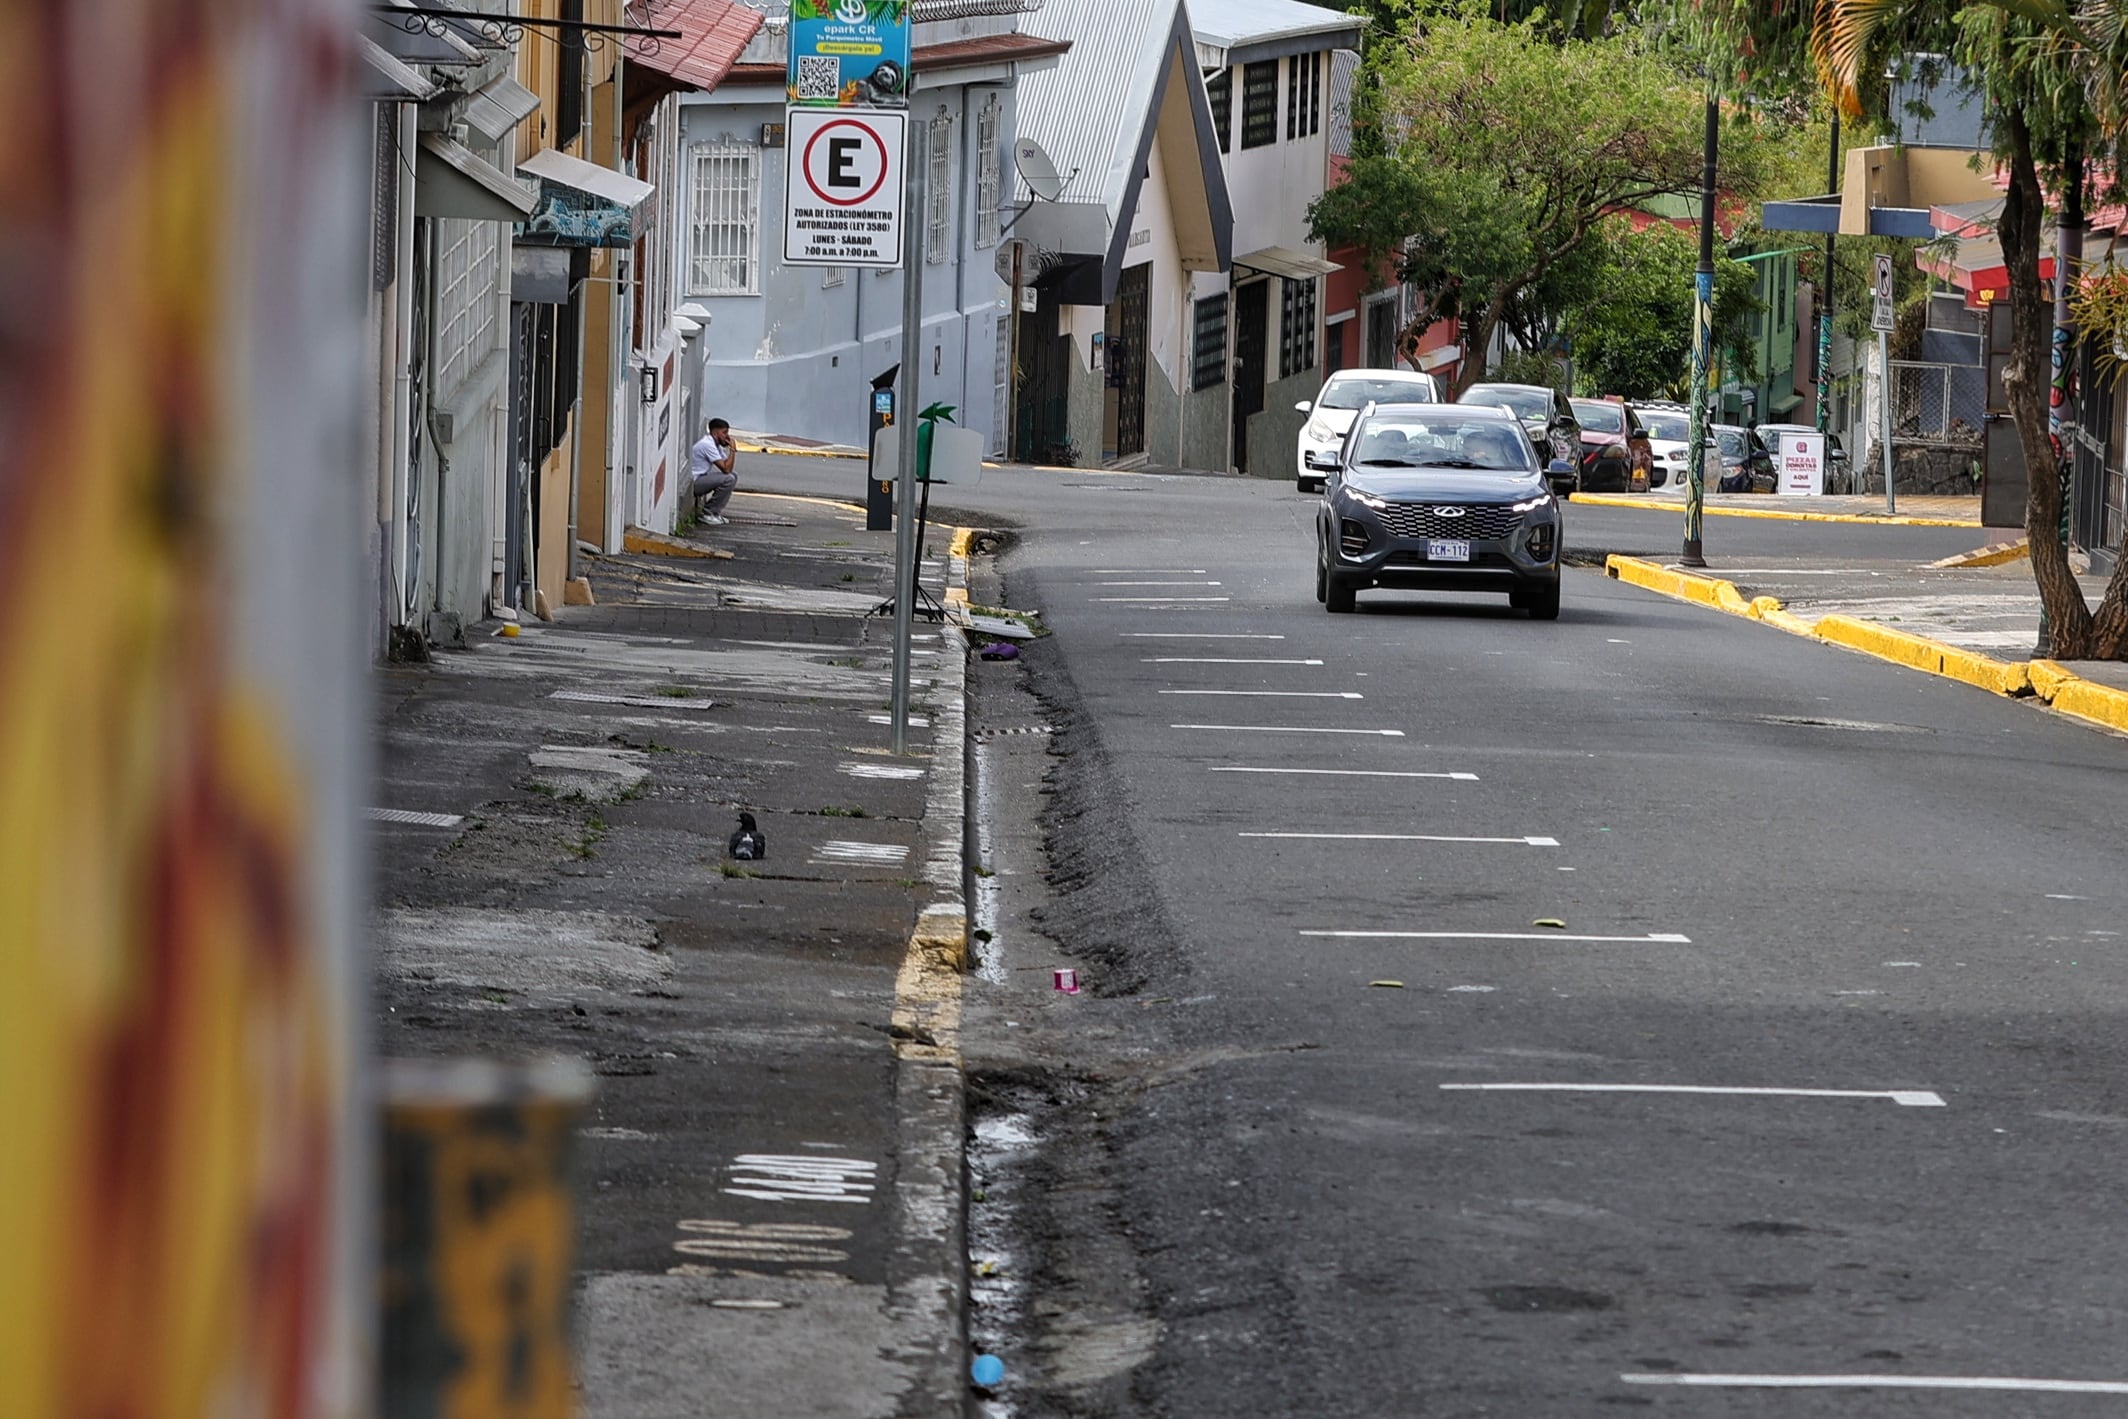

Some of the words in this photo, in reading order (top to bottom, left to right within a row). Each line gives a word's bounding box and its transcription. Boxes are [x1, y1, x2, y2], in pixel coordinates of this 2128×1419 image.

[824, 25, 855, 35] epark
[859, 25, 876, 34] CR
[1022, 149, 1035, 158] SKY
[828, 138, 862, 187] E
[794, 208, 814, 218] ZONA
[815, 208, 825, 218] DE
[826, 209, 893, 220] ESTACIONÓMETRO
[796, 220, 849, 231] AUTORIZADOS
[850, 222, 865, 231] (LEY
[866, 222, 891, 232] 3580)
[812, 234, 836, 244] LUNES
[841, 235, 873, 245] SÁBADO
[805, 246, 821, 256] 7:00
[822, 247, 837, 256] a.m.
[846, 247, 862, 257] 7:00
[863, 249, 879, 258] p.m.
[1430, 545, 1468, 557] CCM-112
